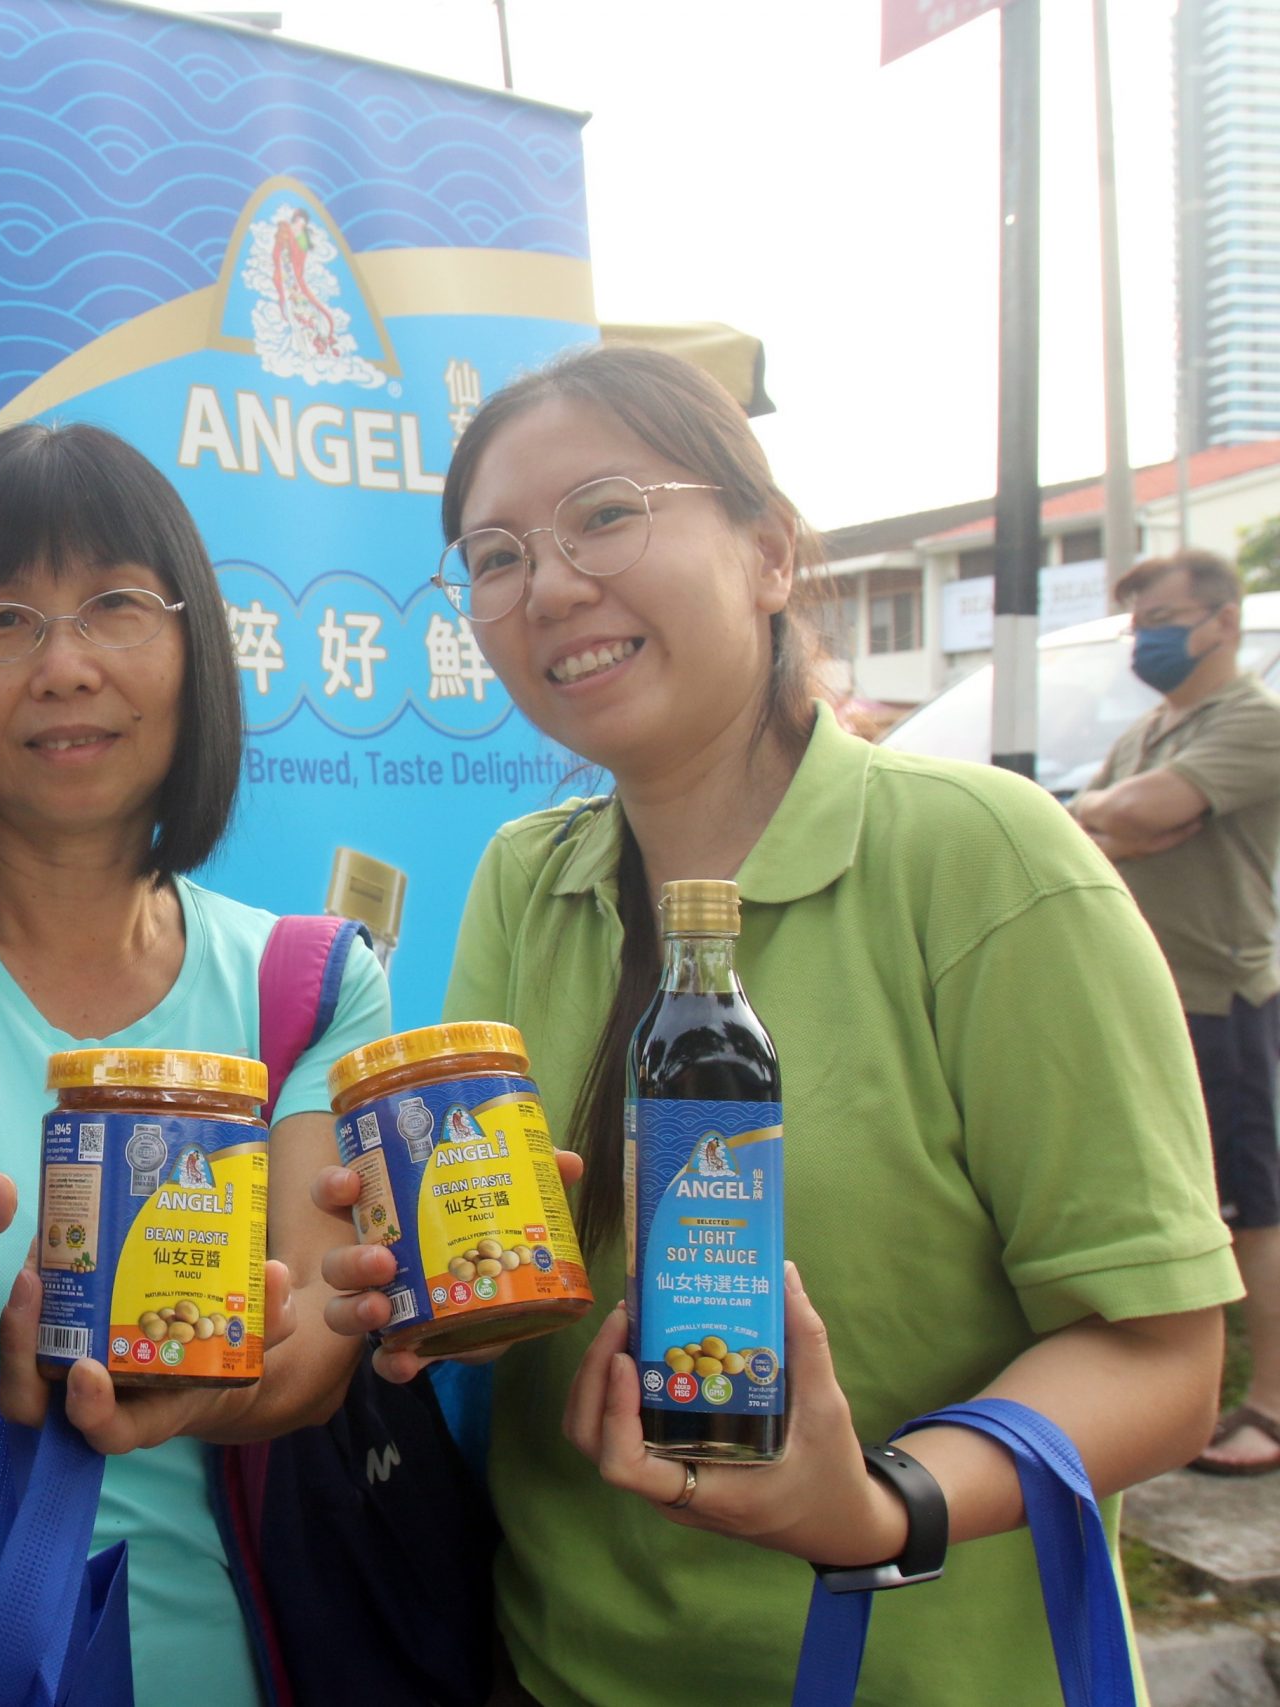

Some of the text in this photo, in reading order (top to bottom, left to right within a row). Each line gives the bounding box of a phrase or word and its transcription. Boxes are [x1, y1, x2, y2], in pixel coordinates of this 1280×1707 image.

[178, 383, 445, 495] ANGEL
[247, 749, 358, 789] Brewed,
[365, 751, 444, 786] Taste
[54, 1123, 72, 1136] 1945
[435, 1142, 499, 1169] ANGEL
[432, 1173, 513, 1198] BEAN PASTE
[676, 1180, 750, 1200] ANGEL
[752, 1168, 764, 1200] 仙女牌
[156, 1191, 223, 1213] ANGEL
[467, 1212, 495, 1223] TAUCU
[144, 1226, 229, 1246] BEAN PASTE
[448, 1229, 501, 1247] NATURALLY FERMENTED
[688, 1229, 737, 1245] LIGHT
[666, 1247, 758, 1265] SOY SAUCE
[174, 1270, 202, 1280] TAUCU
[656, 1271, 770, 1295] 仙女特選生抽
[144, 1290, 203, 1299] NATURALLY FERMENTED
[673, 1295, 752, 1307] KICAP SOYA CAIR
[665, 1322, 728, 1335] NATURALLY BREWED
[677, 1376, 688, 1384] NO
[674, 1389, 690, 1398] MSG
[708, 1388, 725, 1397] GMO
[748, 1399, 761, 1407] 370
